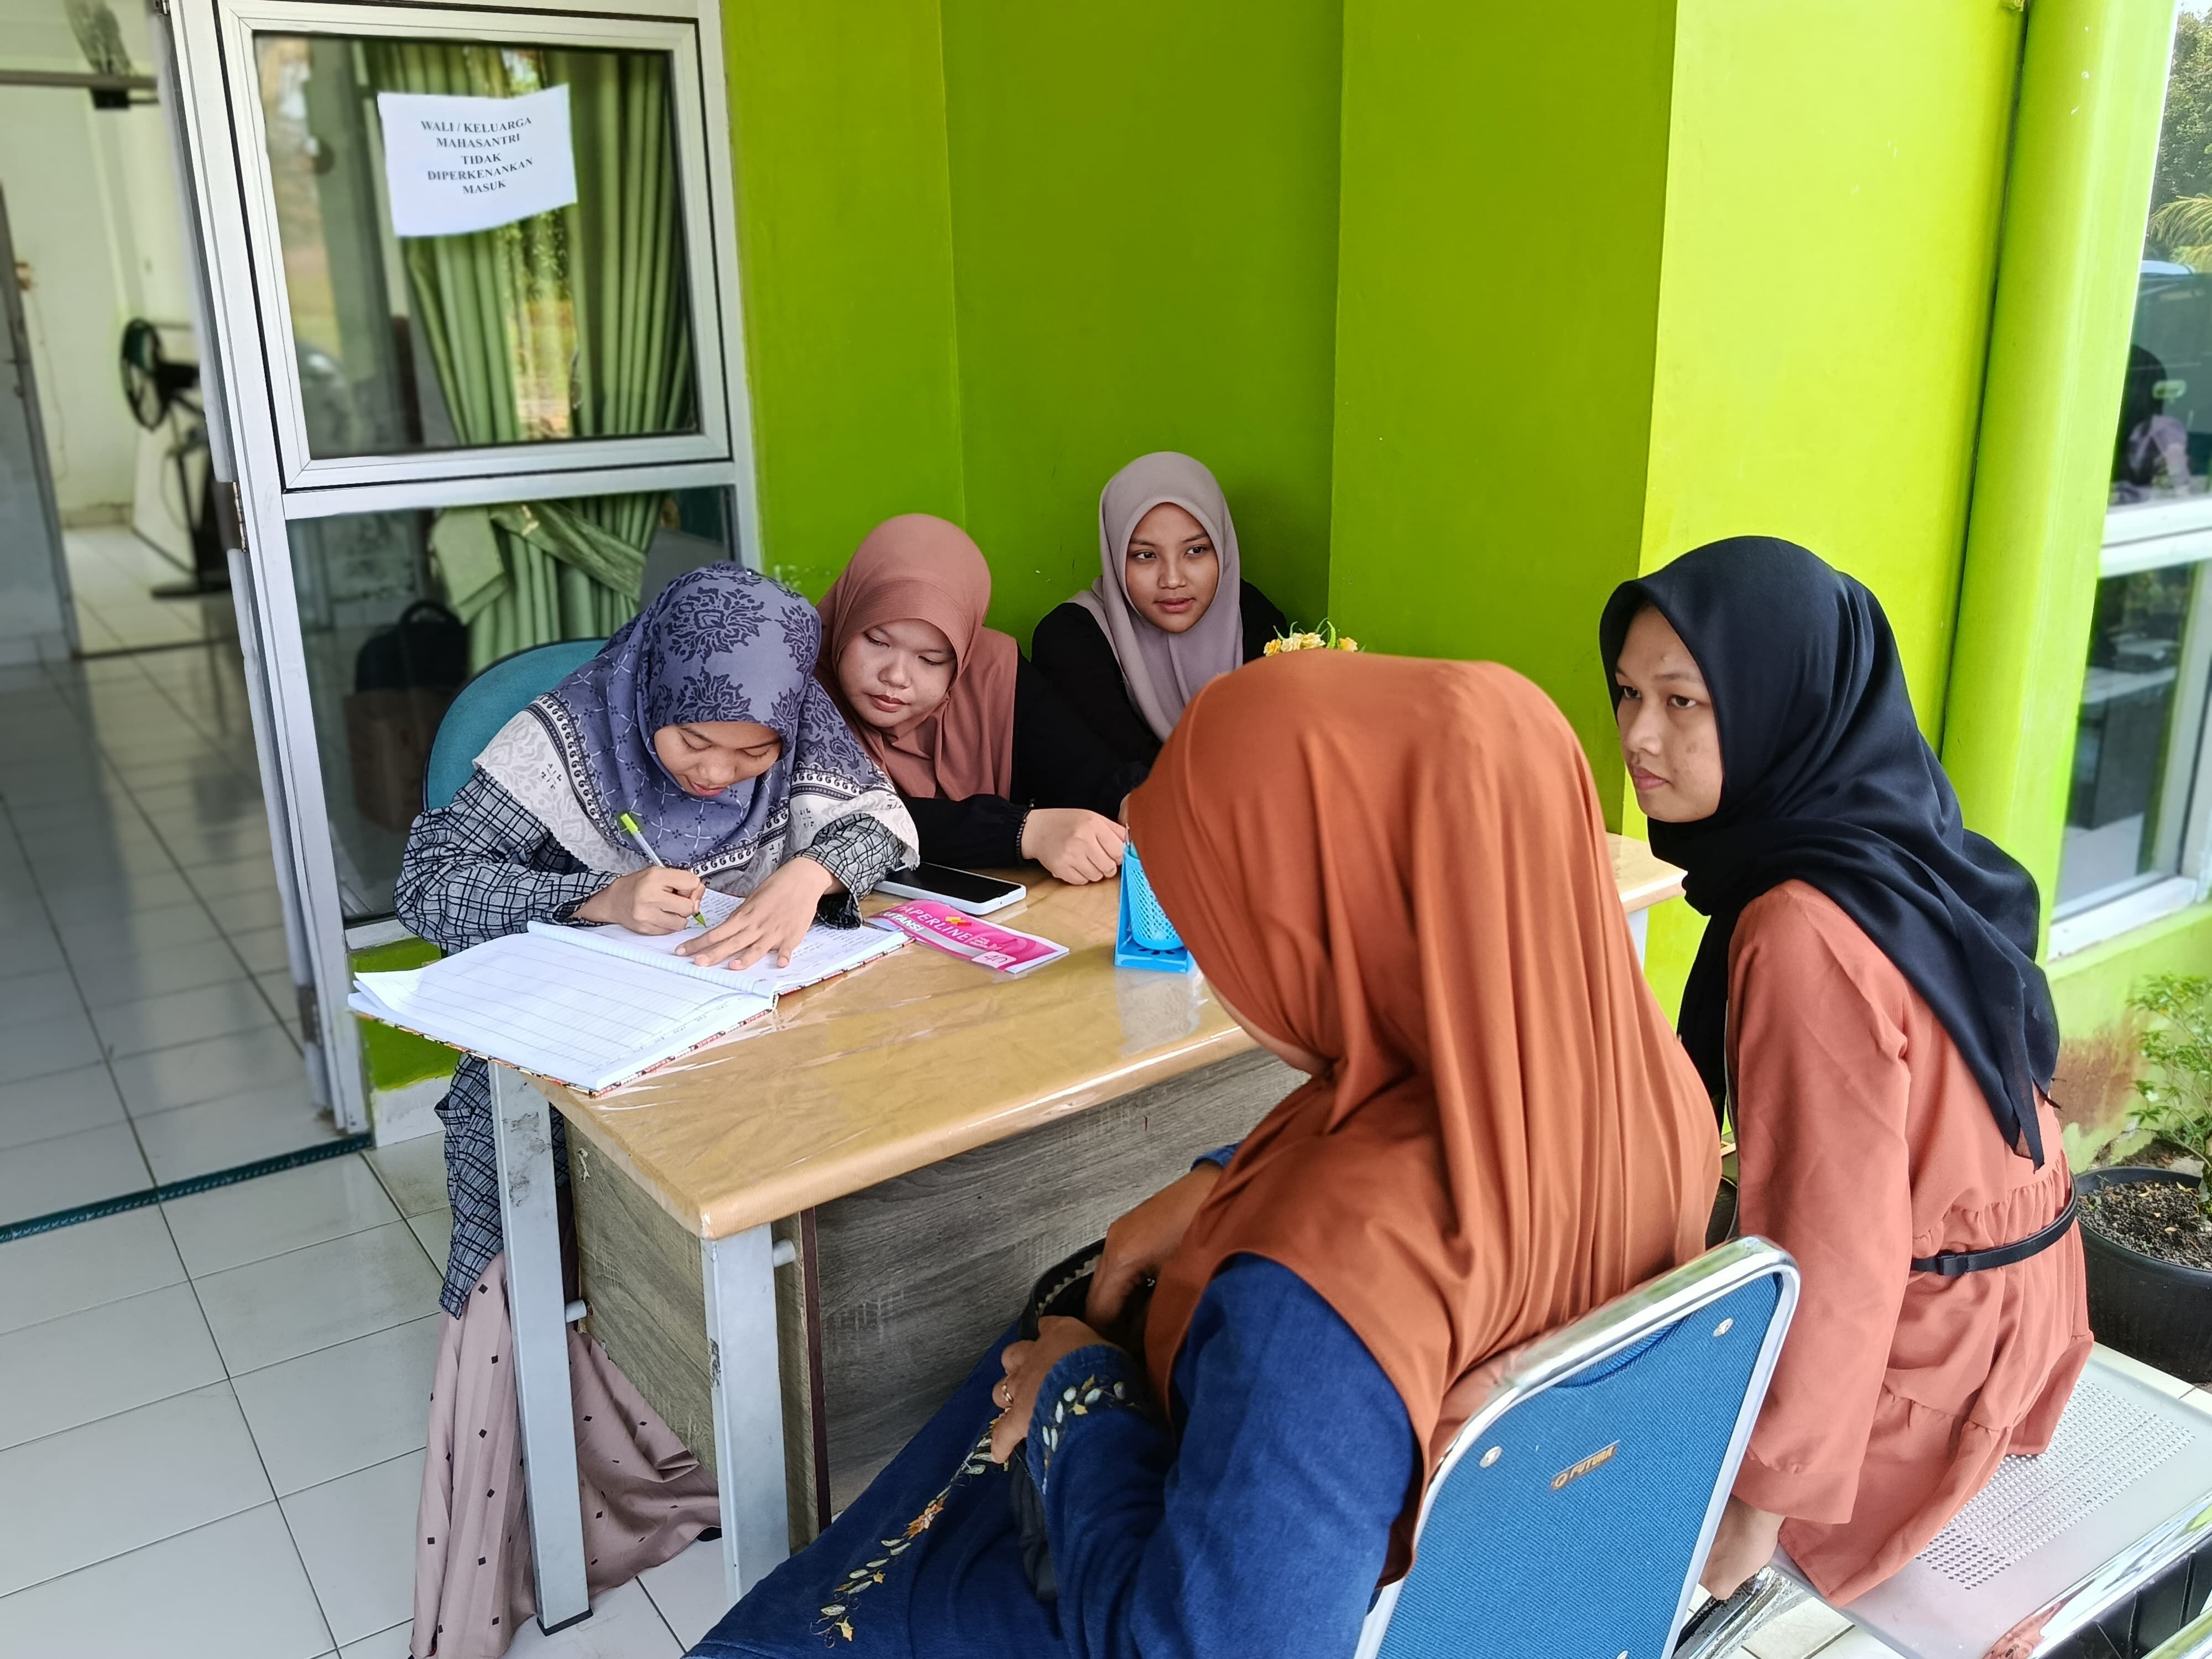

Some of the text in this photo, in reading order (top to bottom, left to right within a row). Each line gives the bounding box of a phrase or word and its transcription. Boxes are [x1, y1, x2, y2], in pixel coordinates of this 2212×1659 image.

[420, 121, 453, 132] WALI
[464, 117, 531, 133] KELUARGA
[436, 133, 520, 148] MAHASANTRI
[461, 153, 502, 165] TIDAK
[427, 158, 533, 180] DIPERKENANKAN
[462, 180, 506, 194] MASUK
[883, 911, 925, 932] ITANSI
[1569, 1446, 1616, 1479] FUTURA
